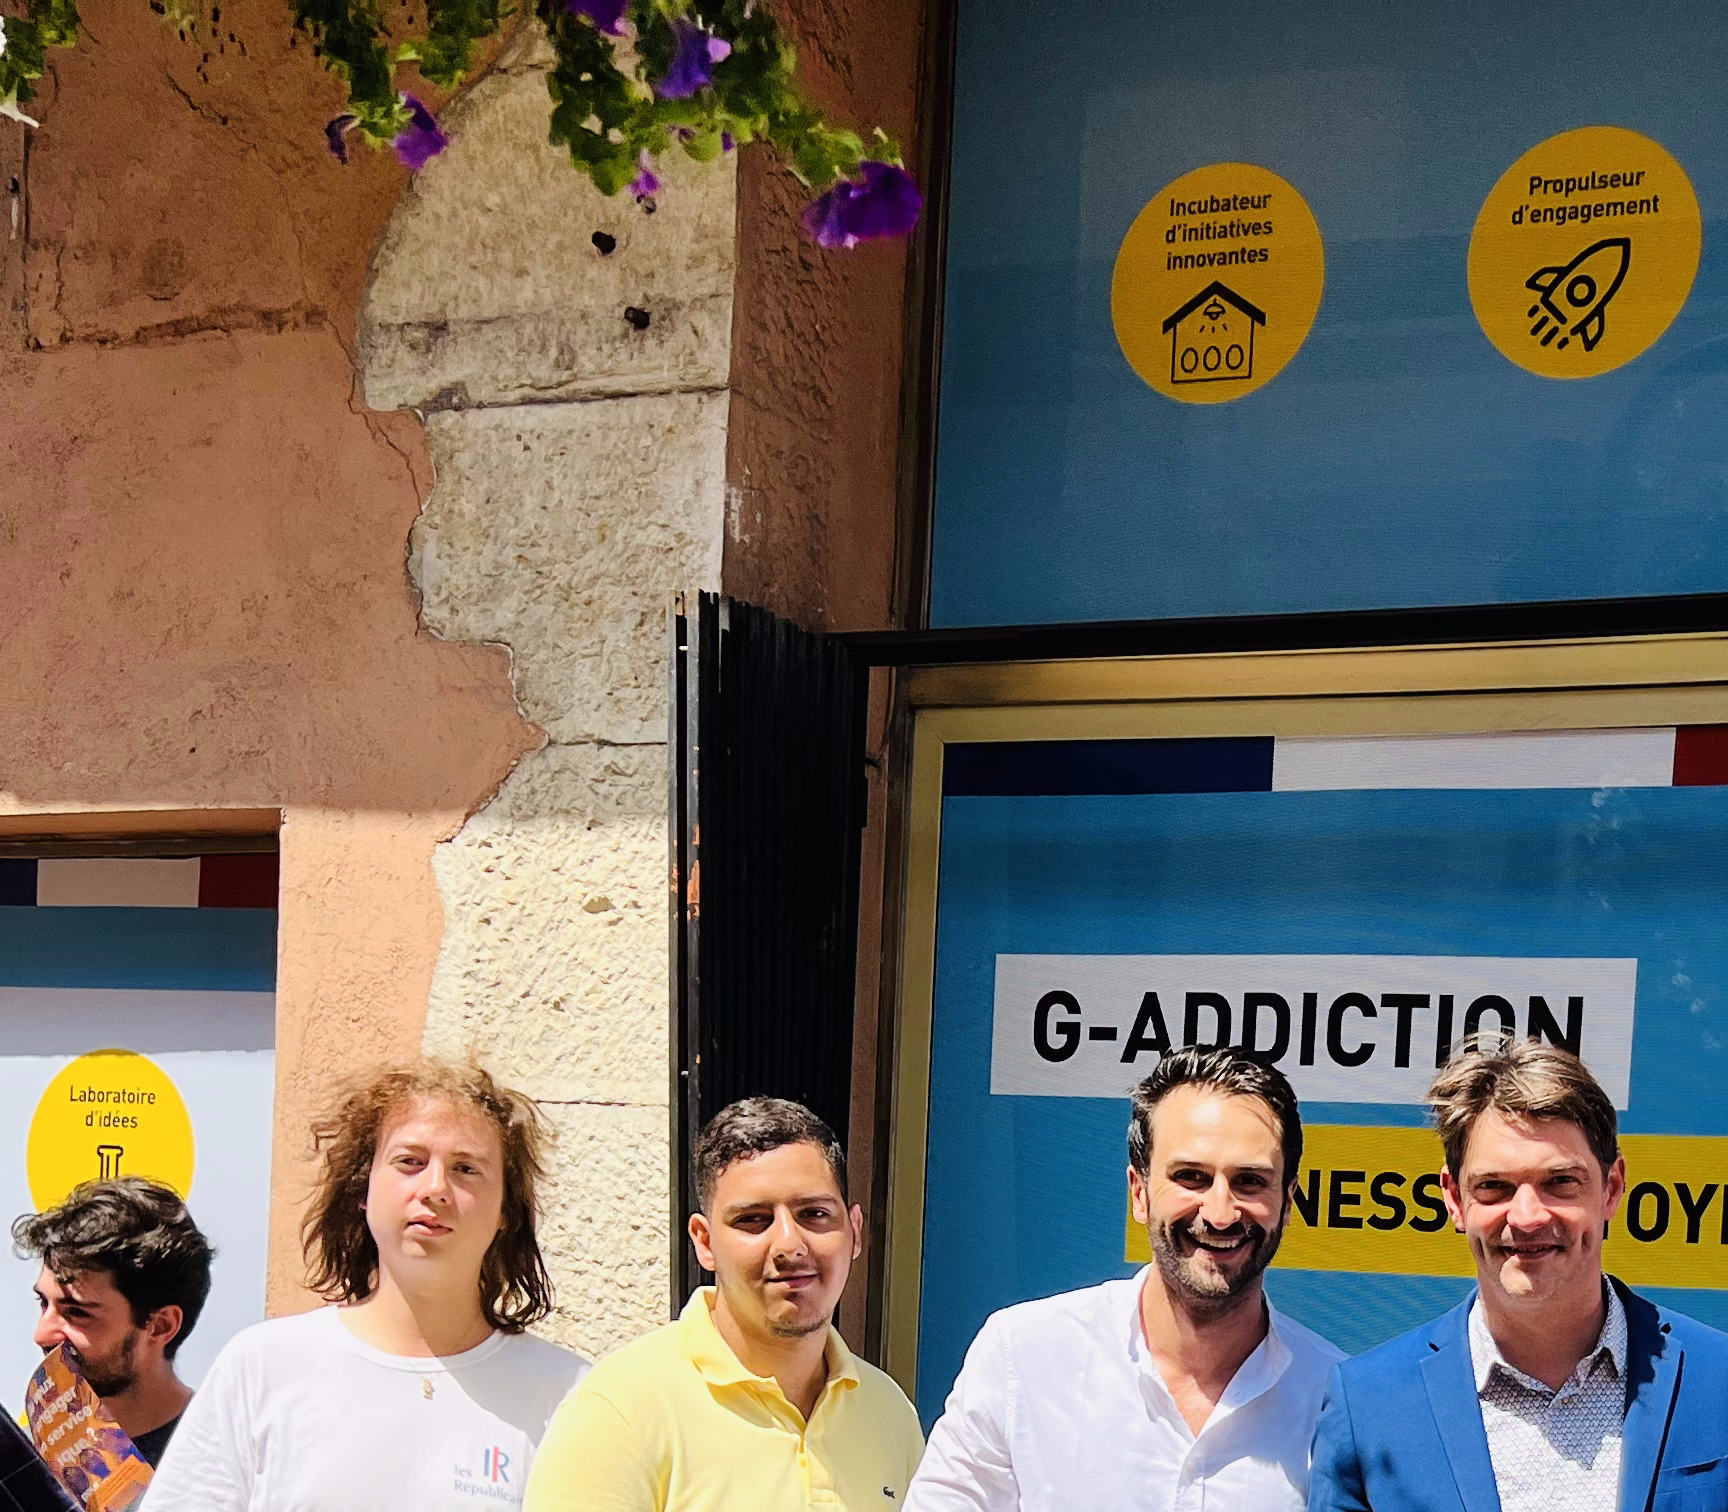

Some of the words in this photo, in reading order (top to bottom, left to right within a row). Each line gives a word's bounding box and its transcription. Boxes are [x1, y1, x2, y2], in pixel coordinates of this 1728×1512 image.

[1528, 170, 1646, 198] Propulseur
[1169, 193, 1272, 217] Incubateur
[1511, 194, 1660, 226] d'engagement
[1165, 218, 1274, 244] d'initiatives
[1166, 246, 1269, 271] innovantes
[1033, 989, 1584, 1068] G-ADDICTION
[69, 1085, 156, 1105] Laboratoire
[85, 1110, 138, 1129] d'idées
[1292, 1168, 1466, 1235] NESS
[454, 1479, 523, 1505] Républicai
